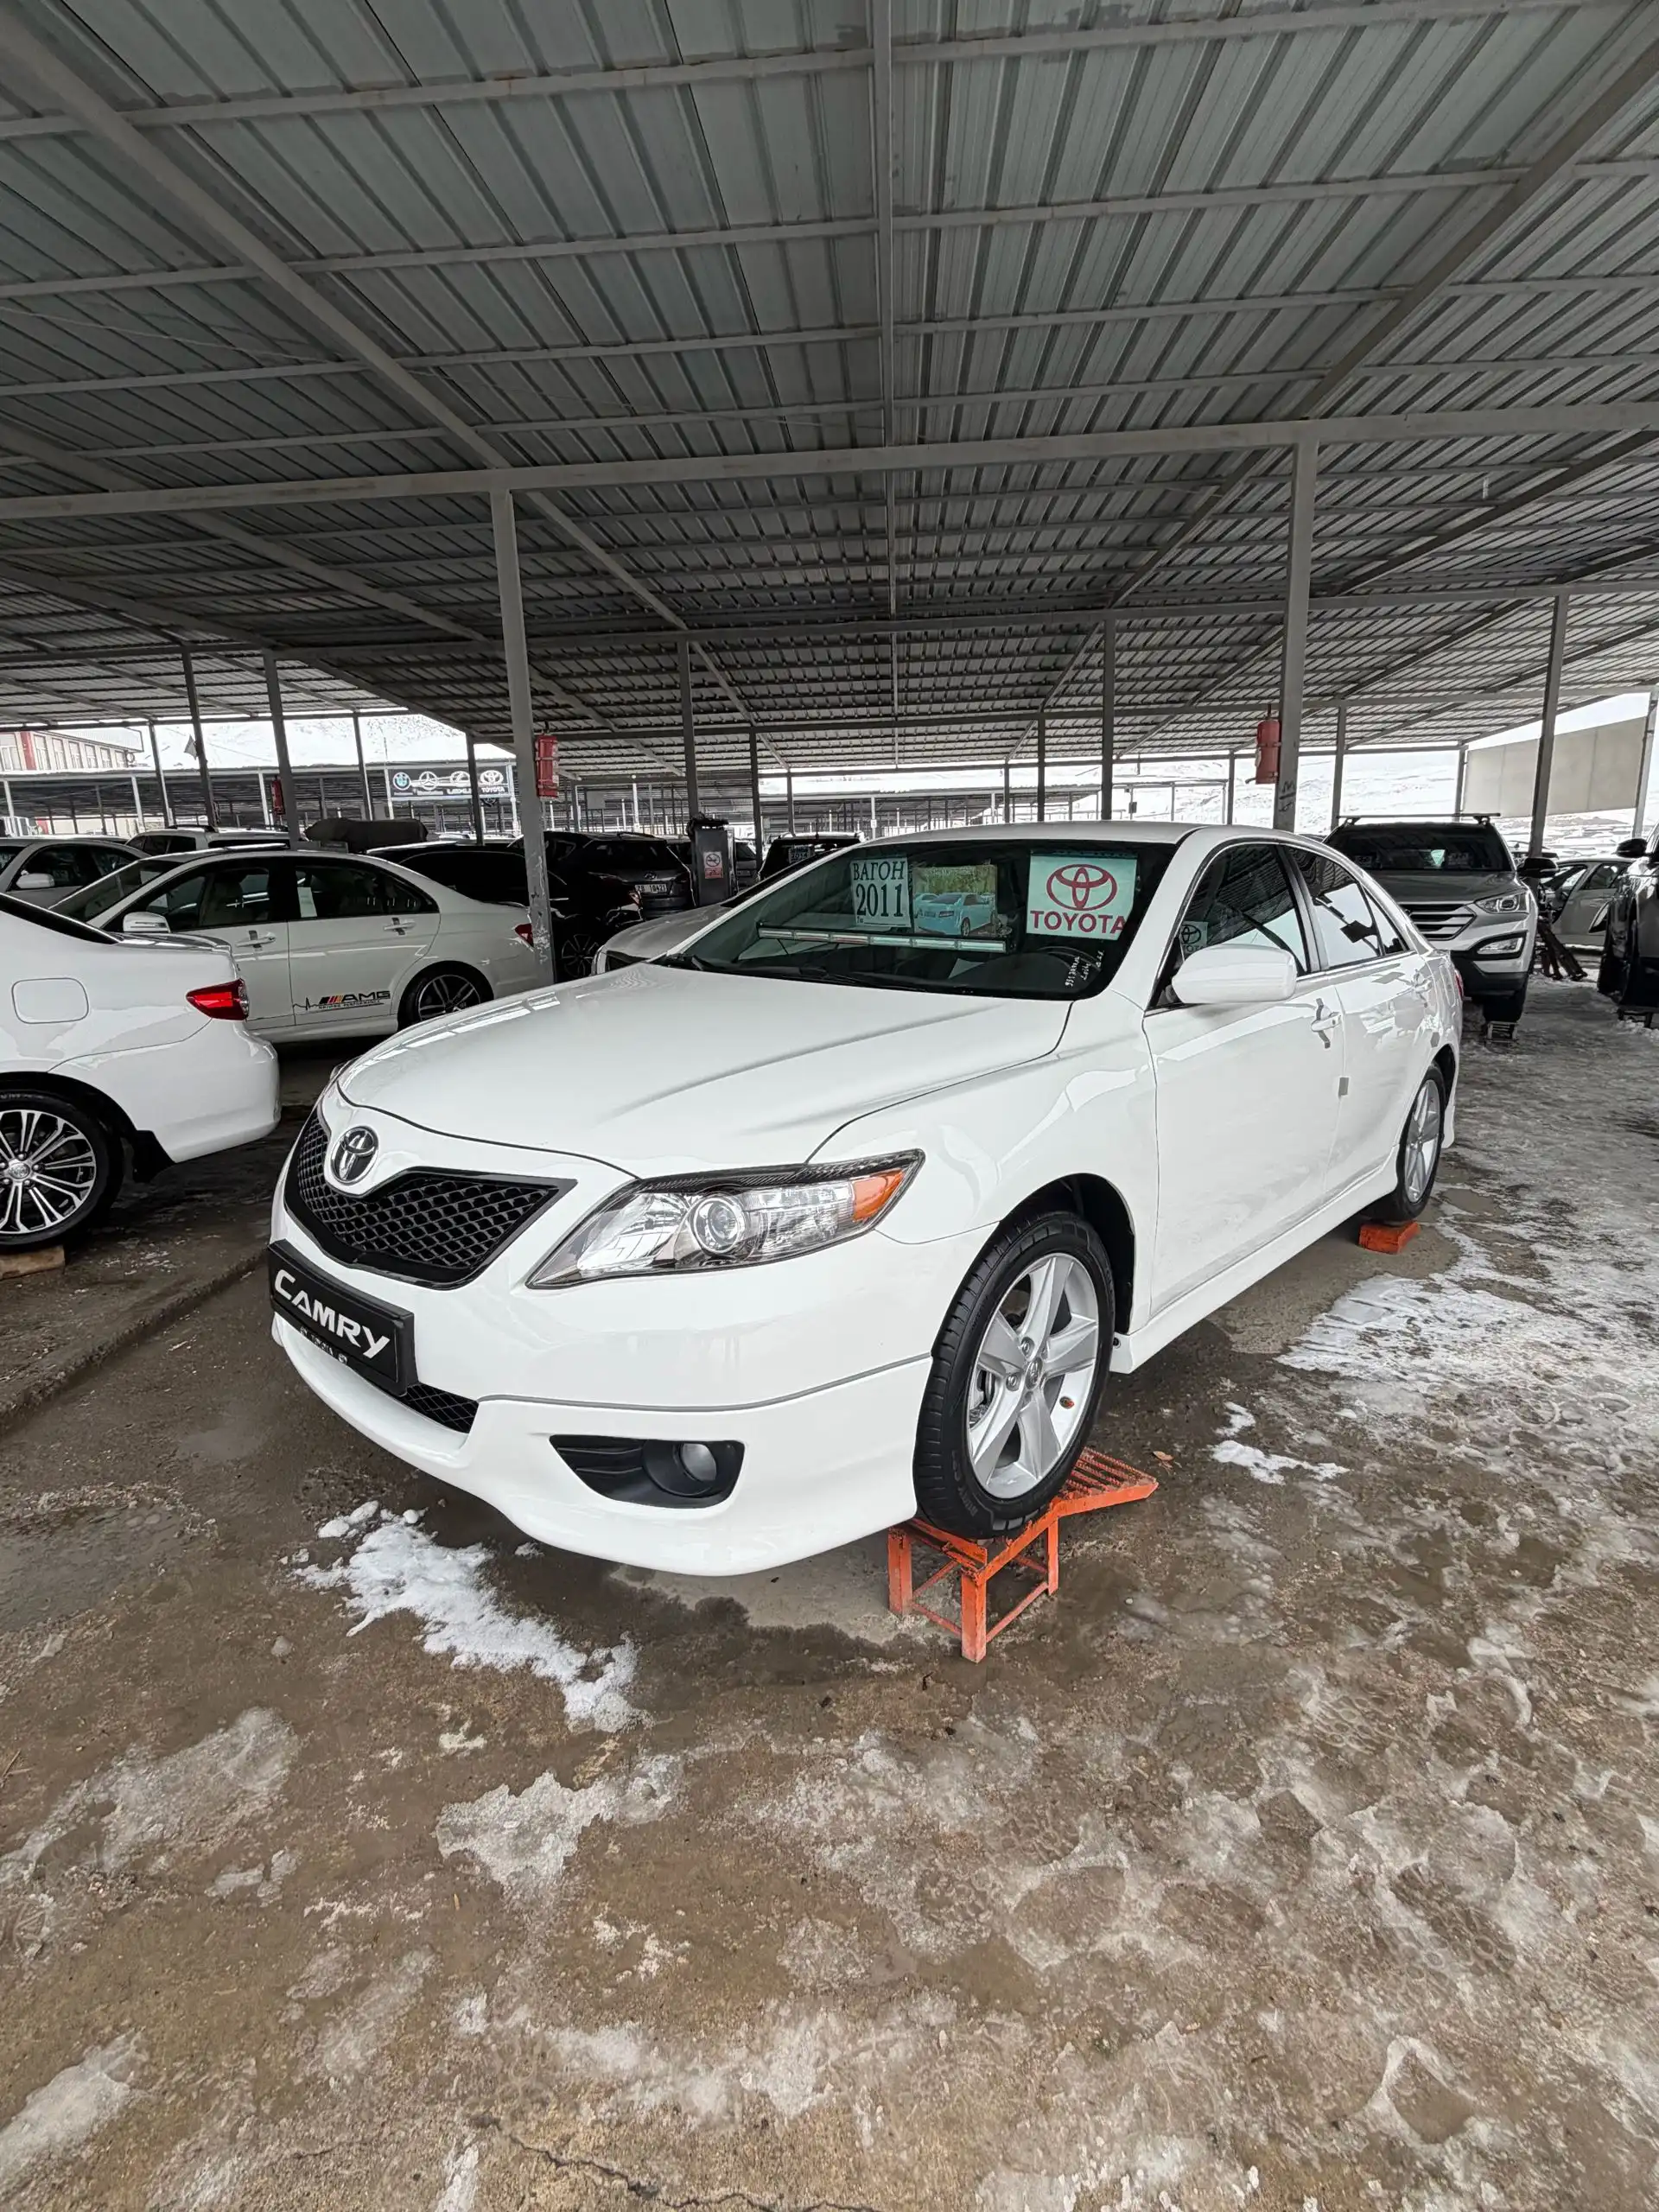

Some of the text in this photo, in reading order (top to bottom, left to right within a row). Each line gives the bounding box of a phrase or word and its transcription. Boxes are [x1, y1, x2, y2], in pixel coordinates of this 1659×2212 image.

[853, 861, 906, 880] ВАГОН
[855, 883, 904, 918] 2011
[1029, 910, 1127, 934] TOYOTA
[340, 990, 391, 1003] AMG
[274, 1268, 391, 1359] CAMRY
